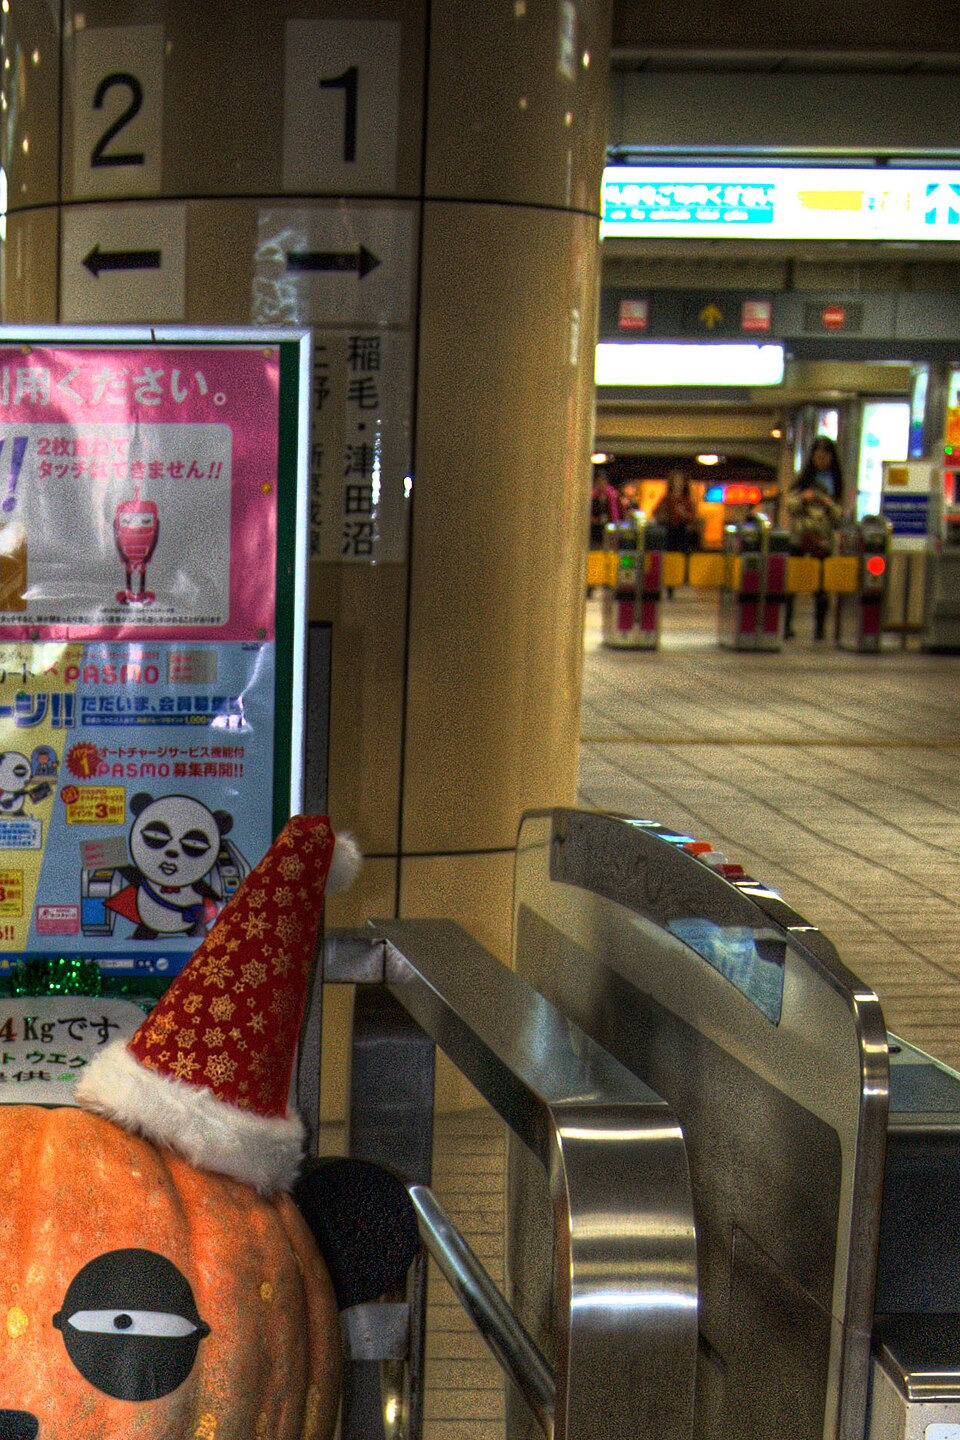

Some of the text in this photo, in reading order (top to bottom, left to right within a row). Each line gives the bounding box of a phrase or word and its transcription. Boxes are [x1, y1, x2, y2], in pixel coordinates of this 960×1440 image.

[91, 73, 145, 168] 2
[320, 66, 358, 163] 1
[343, 336, 381, 556] 稲毛・津田沼
[64, 664, 160, 685] PASMO
[96, 763, 170, 778] PASMO
